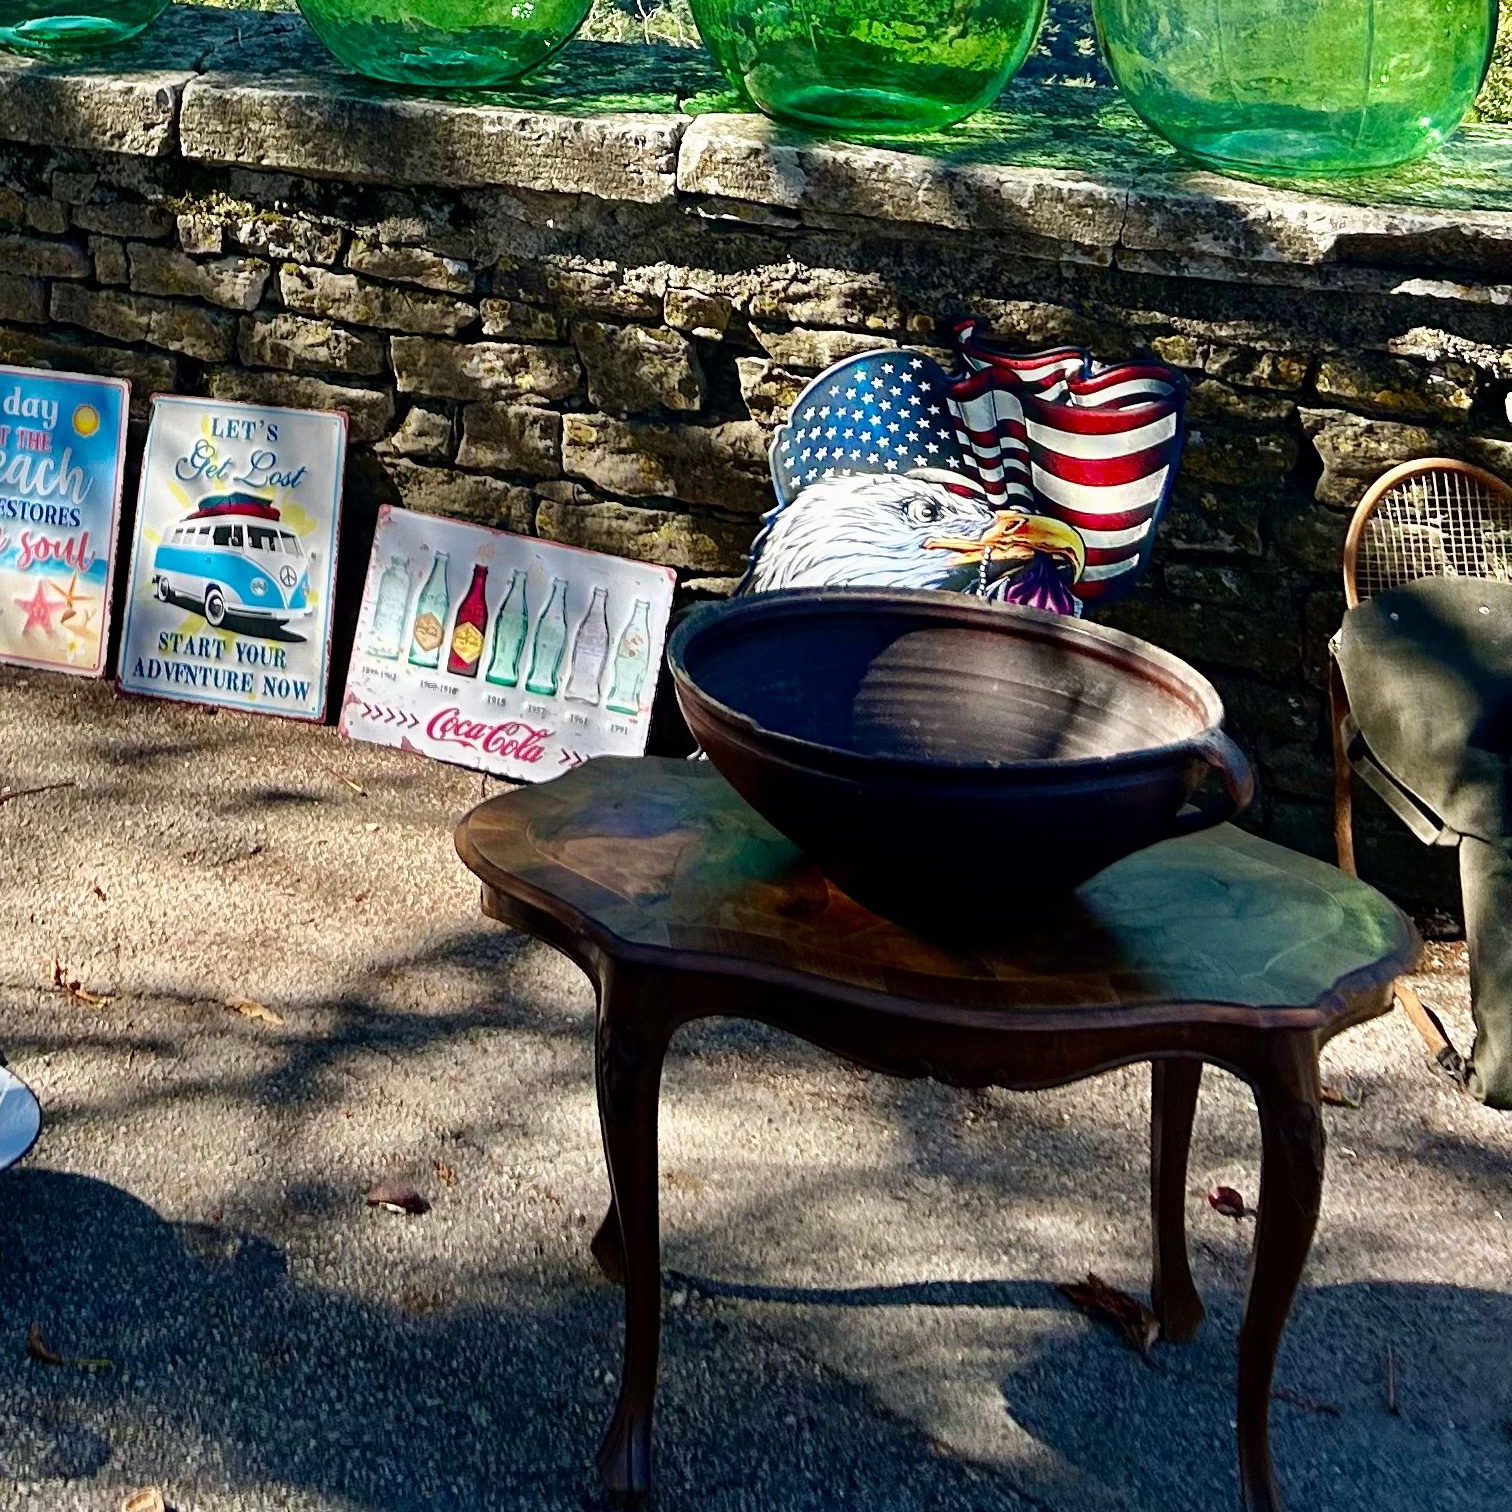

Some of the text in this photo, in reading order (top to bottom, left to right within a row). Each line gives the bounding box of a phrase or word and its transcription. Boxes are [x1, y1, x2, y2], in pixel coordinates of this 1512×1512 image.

[3, 386, 59, 430] day
[15, 427, 53, 452] THE
[211, 417, 278, 443] LET'S
[175, 438, 308, 489] Get Lost
[16, 530, 96, 573] soul
[158, 631, 287, 670] START YOUR
[132, 656, 312, 703] ADVENTURE NOW
